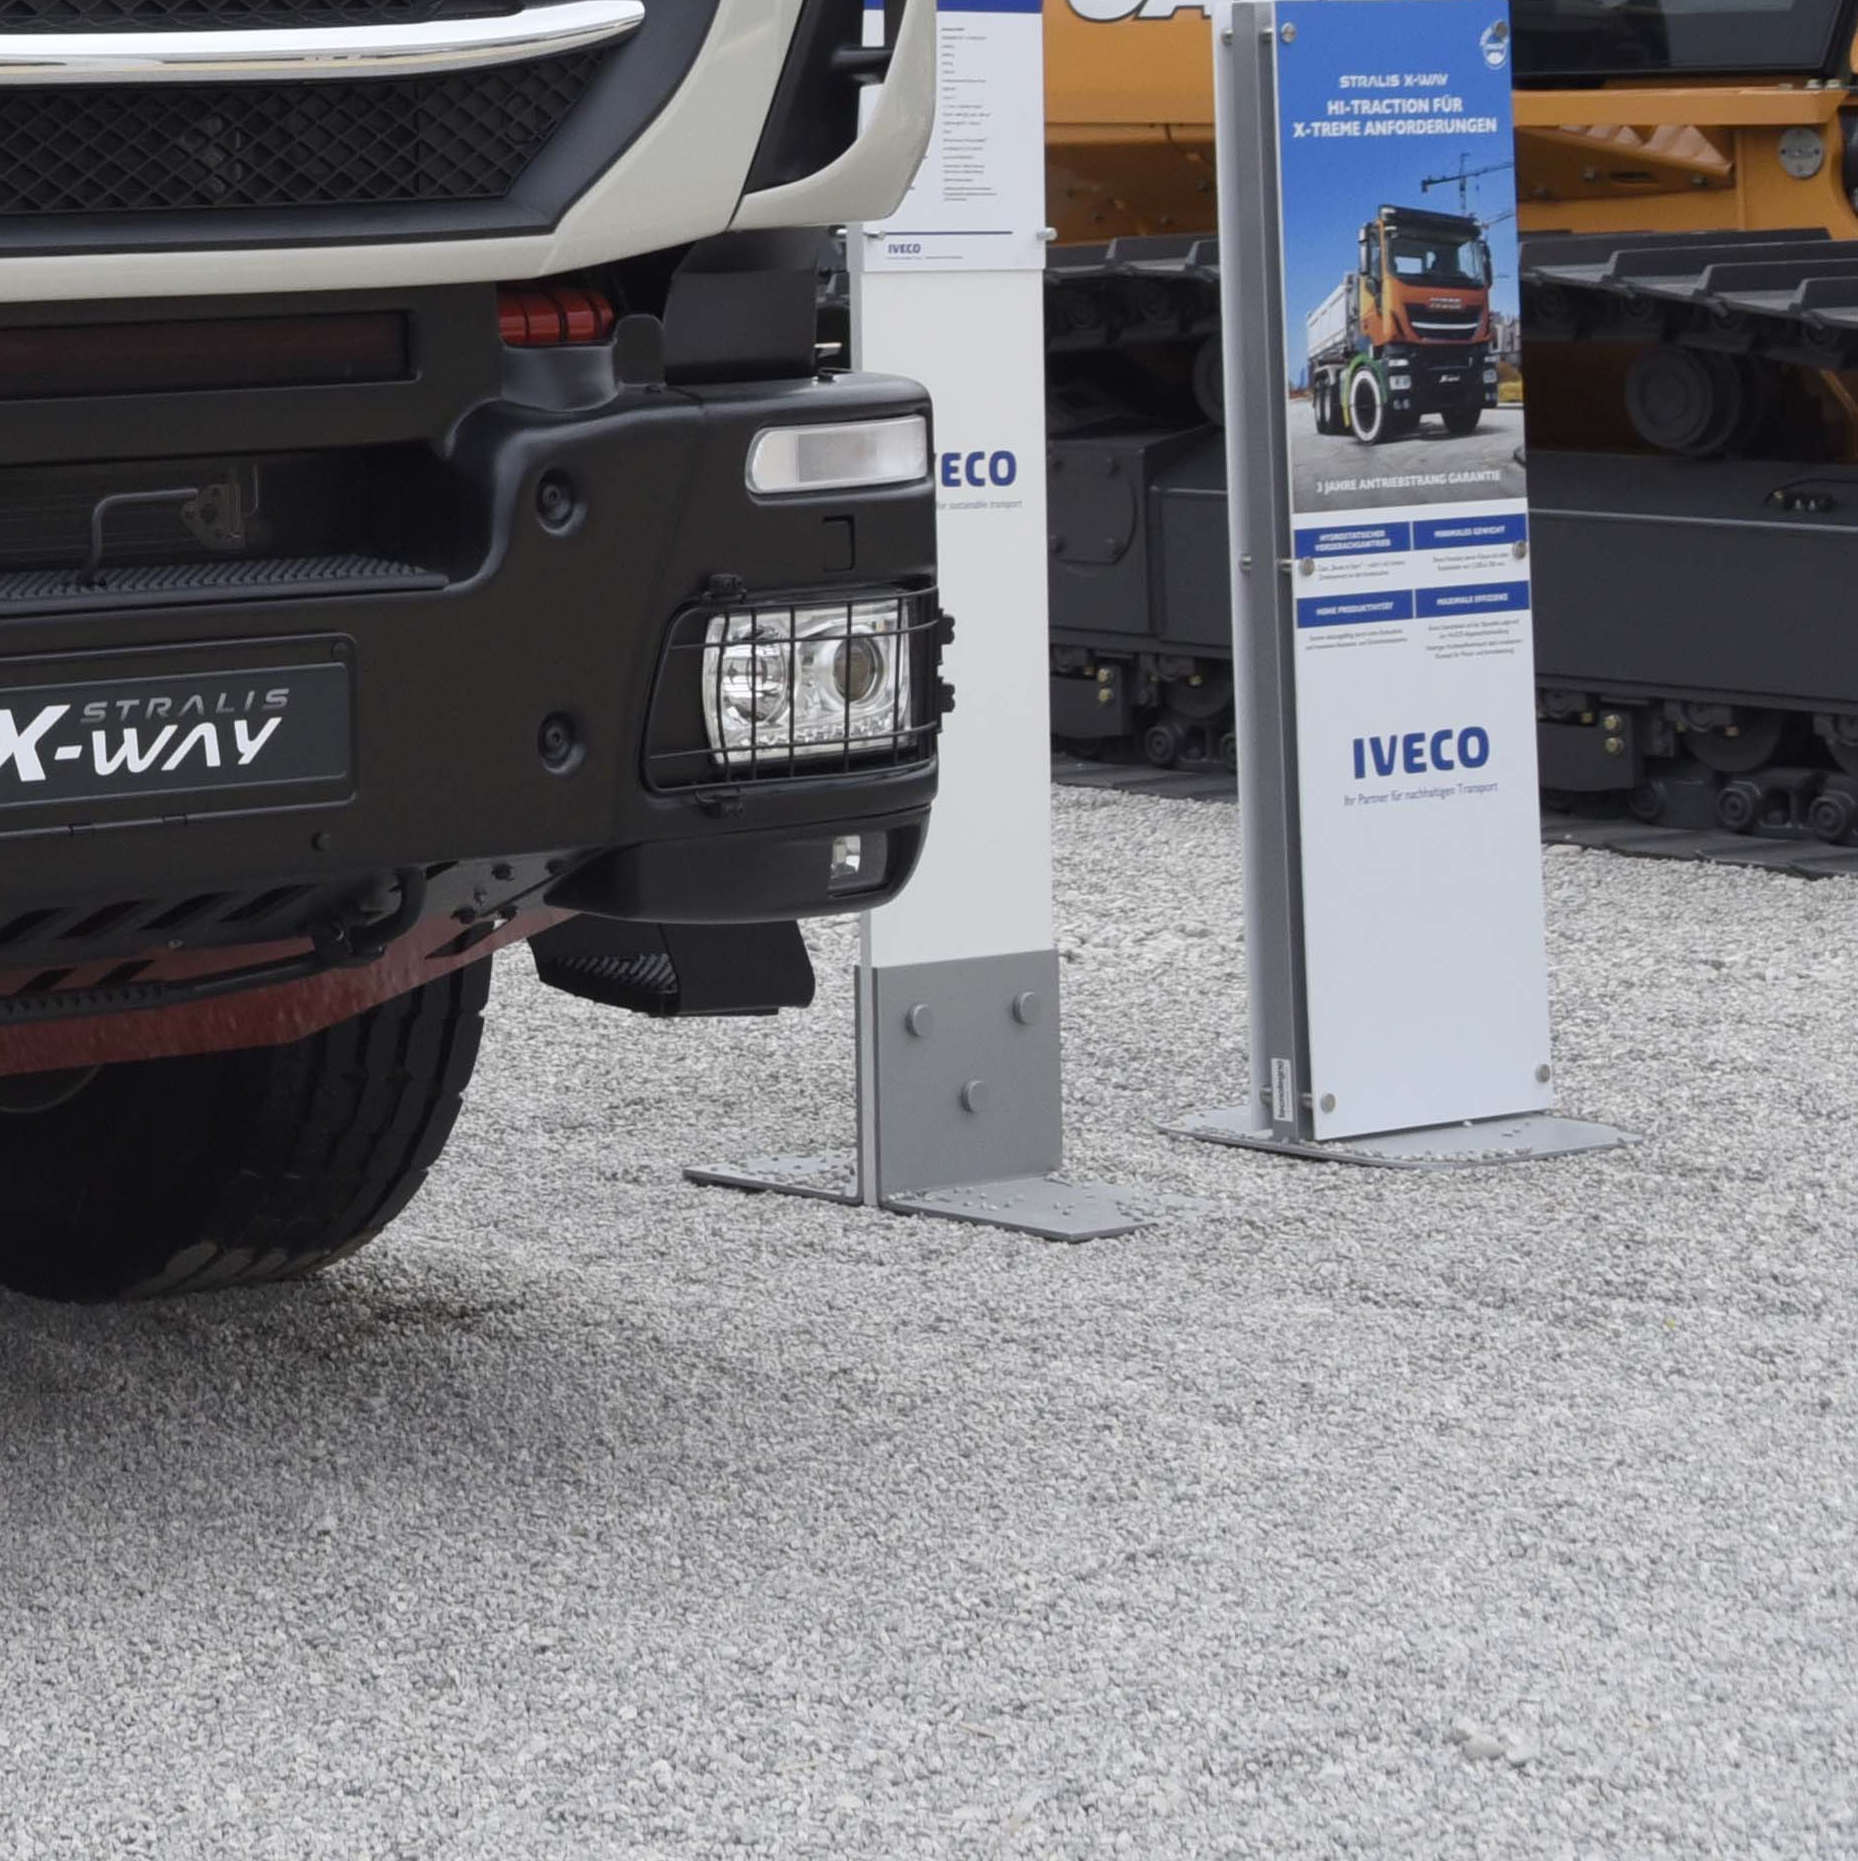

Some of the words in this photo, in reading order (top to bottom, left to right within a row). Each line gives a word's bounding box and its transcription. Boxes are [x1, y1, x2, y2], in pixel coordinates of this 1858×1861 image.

[1339, 74, 1400, 88] STRALIS
[1404, 73, 1449, 87] X-WAY
[1327, 97, 1429, 116] HI-TRACTION
[1433, 94, 1463, 113] FÜR
[1293, 120, 1361, 138] X-TREME
[1364, 117, 1497, 136] ANFORDERUNGEN
[887, 243, 921, 254] IVECO
[940, 449, 1017, 487] ECO
[1324, 479, 1356, 495] JAHRE
[1448, 470, 1501, 484] GARANTIE
[1353, 726, 1489, 779] IVECO
[1358, 792, 1388, 805] Partner
[1457, 782, 1498, 795] Transport
